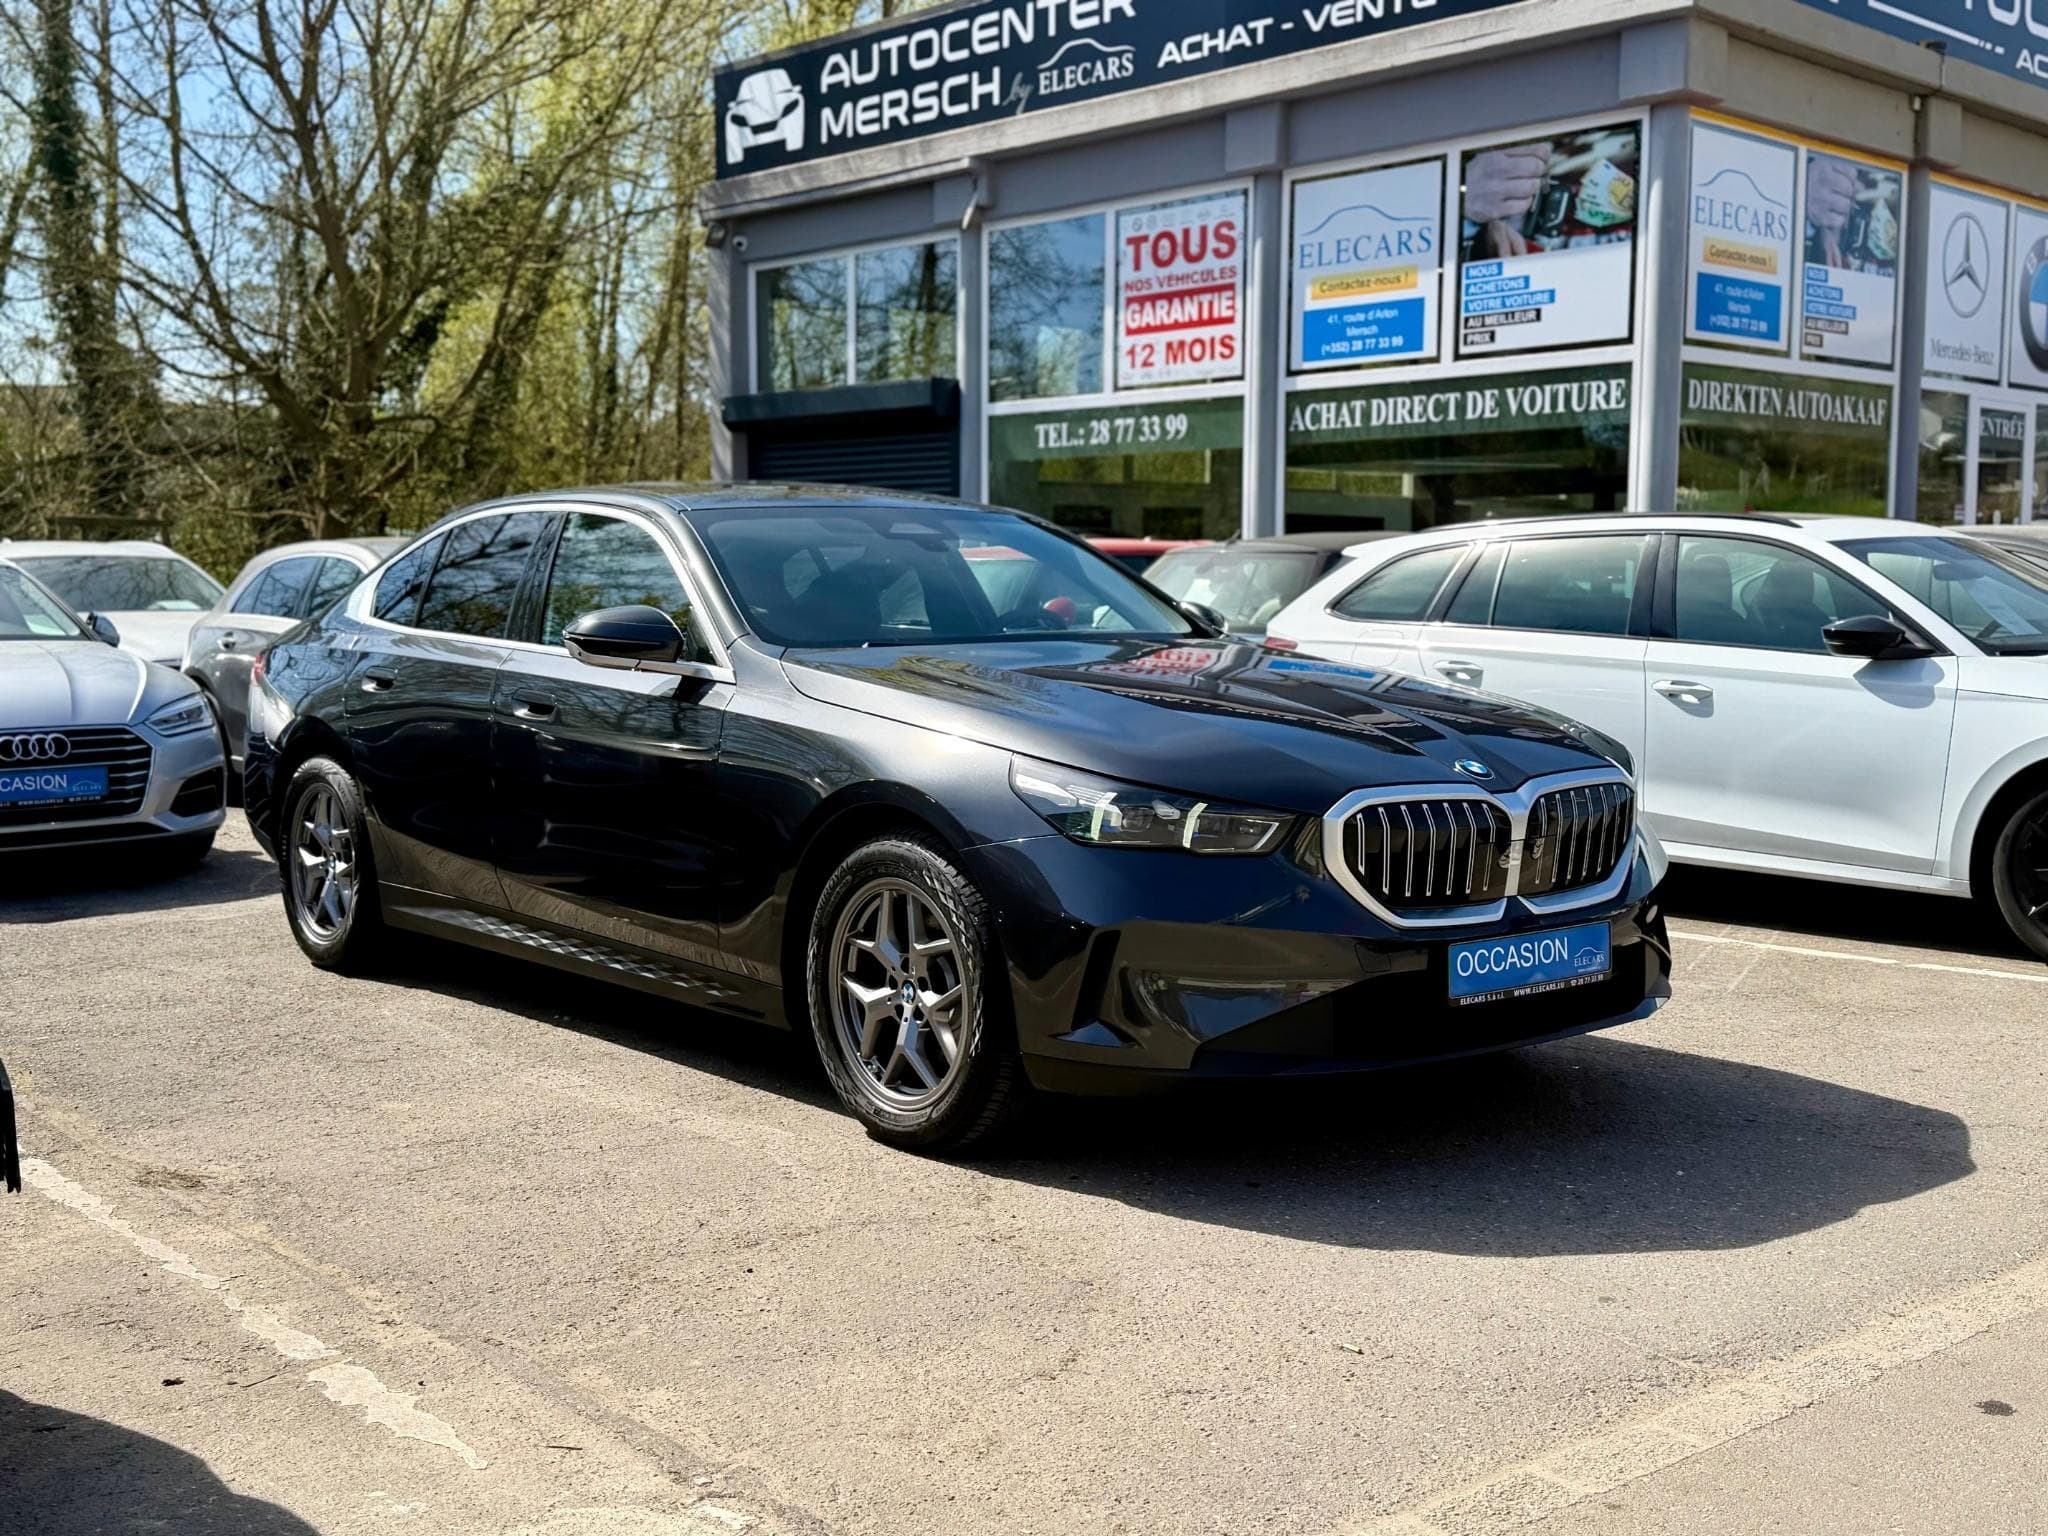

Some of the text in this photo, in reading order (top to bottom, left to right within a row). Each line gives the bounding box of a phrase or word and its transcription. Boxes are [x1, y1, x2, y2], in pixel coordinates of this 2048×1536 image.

[820, 0, 1136, 94] AUTOCENTER
[1157, 17, 1274, 68] ACHAT
[820, 53, 1134, 144] MERSCH by ELECARS
[1694, 195, 1788, 241] ELECARS
[1126, 220, 1237, 272] TOUS
[1299, 226, 1433, 270] ELECARS
[1124, 277, 1152, 293] NOS
[1319, 275, 1402, 293] Contactez-nous
[1468, 278, 1525, 295] ACHETONS
[1469, 266, 1498, 278] NOUS
[1126, 291, 1234, 330] GARANTIE
[1467, 291, 1551, 312] VOTRE VOITURE
[1467, 309, 1537, 328] AU MEILLEUR
[1126, 334, 1235, 369] 12 MOIS
[1466, 331, 1491, 345] PRIX
[1930, 338, 1995, 365] Mercedes-Benz
[1289, 378, 1627, 432] ACHAT DIRECT DE VOITURE
[1688, 378, 1888, 426] DIREKTEN AUTOAKAAF
[1089, 419, 1111, 446] 28
[1113, 416, 1136, 444] 77
[1138, 414, 1161, 442] 33
[1164, 412, 1188, 440] 99
[1979, 415, 2025, 440] ENTRÉE
[0, 774, 67, 792] CASION
[1457, 937, 1568, 977] OCCASION
[1574, 953, 1605, 967] ELECARS
[1460, 995, 1486, 1006] ELECARS
[1513, 981, 1565, 997] WWW.ELECARS.LU
